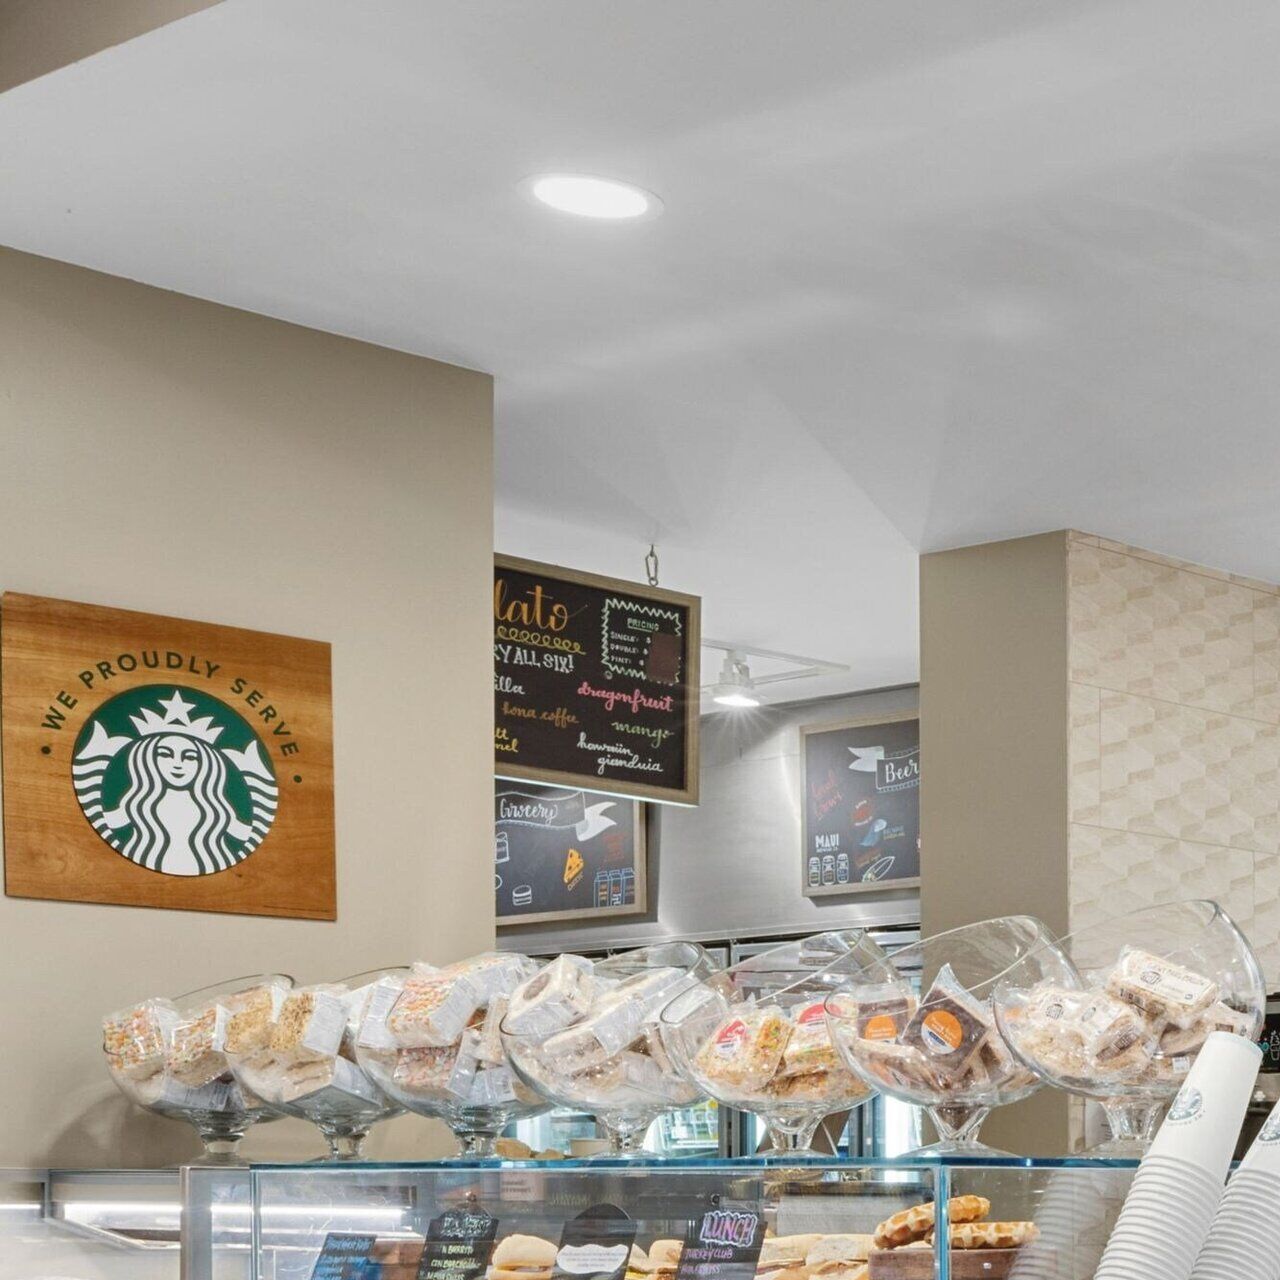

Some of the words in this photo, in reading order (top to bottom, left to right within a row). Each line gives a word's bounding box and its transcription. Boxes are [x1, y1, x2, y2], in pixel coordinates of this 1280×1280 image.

[495, 579, 588, 631] lato
[513, 651, 541, 668] ALL
[543, 655, 574, 674] SIX!
[41, 690, 78, 730] WE
[79, 651, 220, 689] PROUDLY
[230, 678, 299, 757] SERVE
[578, 681, 673, 713] dragonfruit
[611, 721, 674, 748] mango
[500, 799, 558, 825] Grocery
[704, 1214, 754, 1244] LUNCH
